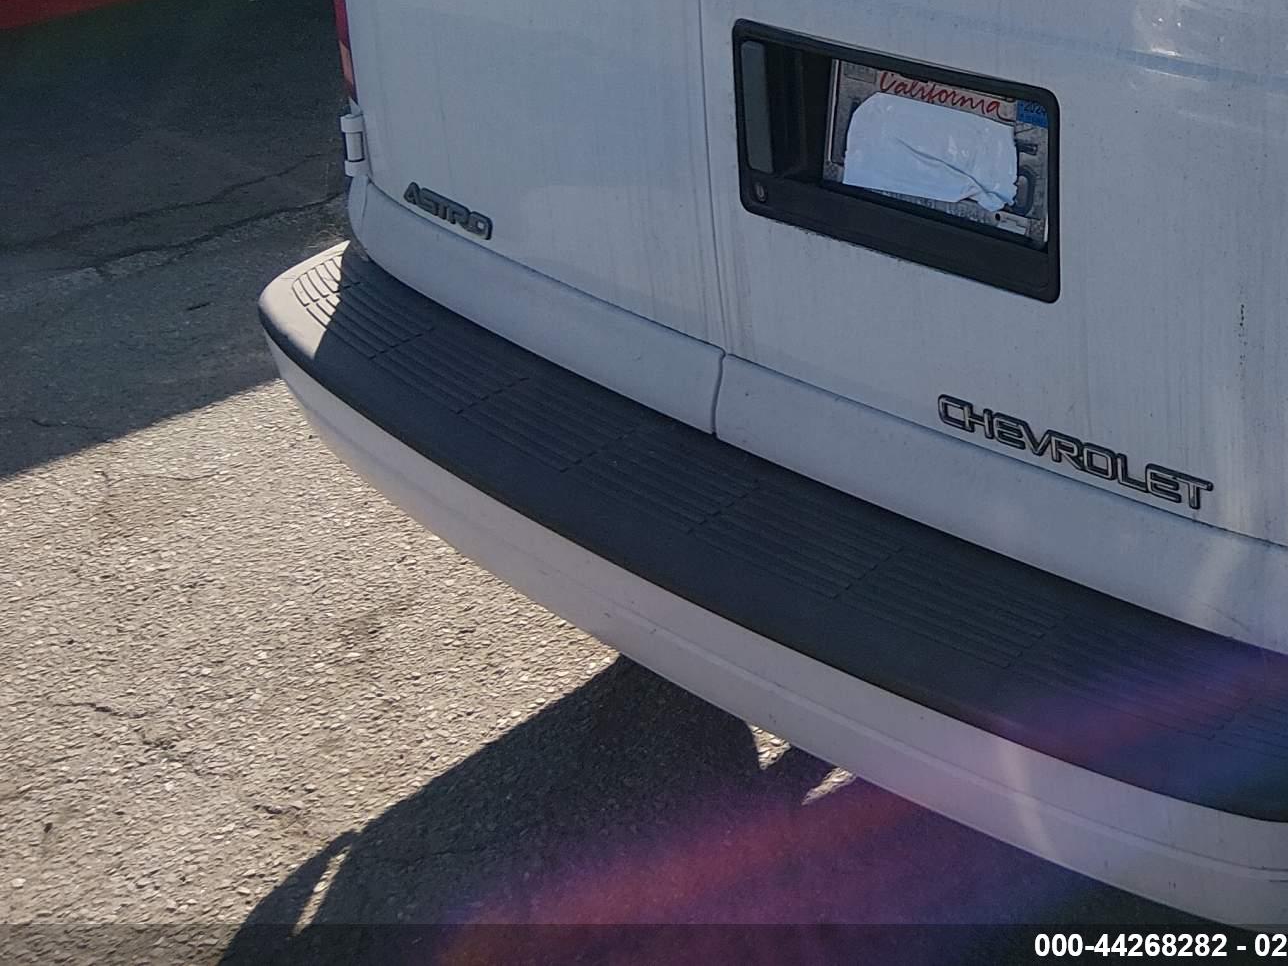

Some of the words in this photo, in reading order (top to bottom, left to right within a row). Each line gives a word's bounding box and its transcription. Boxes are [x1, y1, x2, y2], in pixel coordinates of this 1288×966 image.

[879, 71, 1015, 122] California
[403, 181, 493, 240] ASTRO
[937, 393, 1214, 510] CHEVROLET
